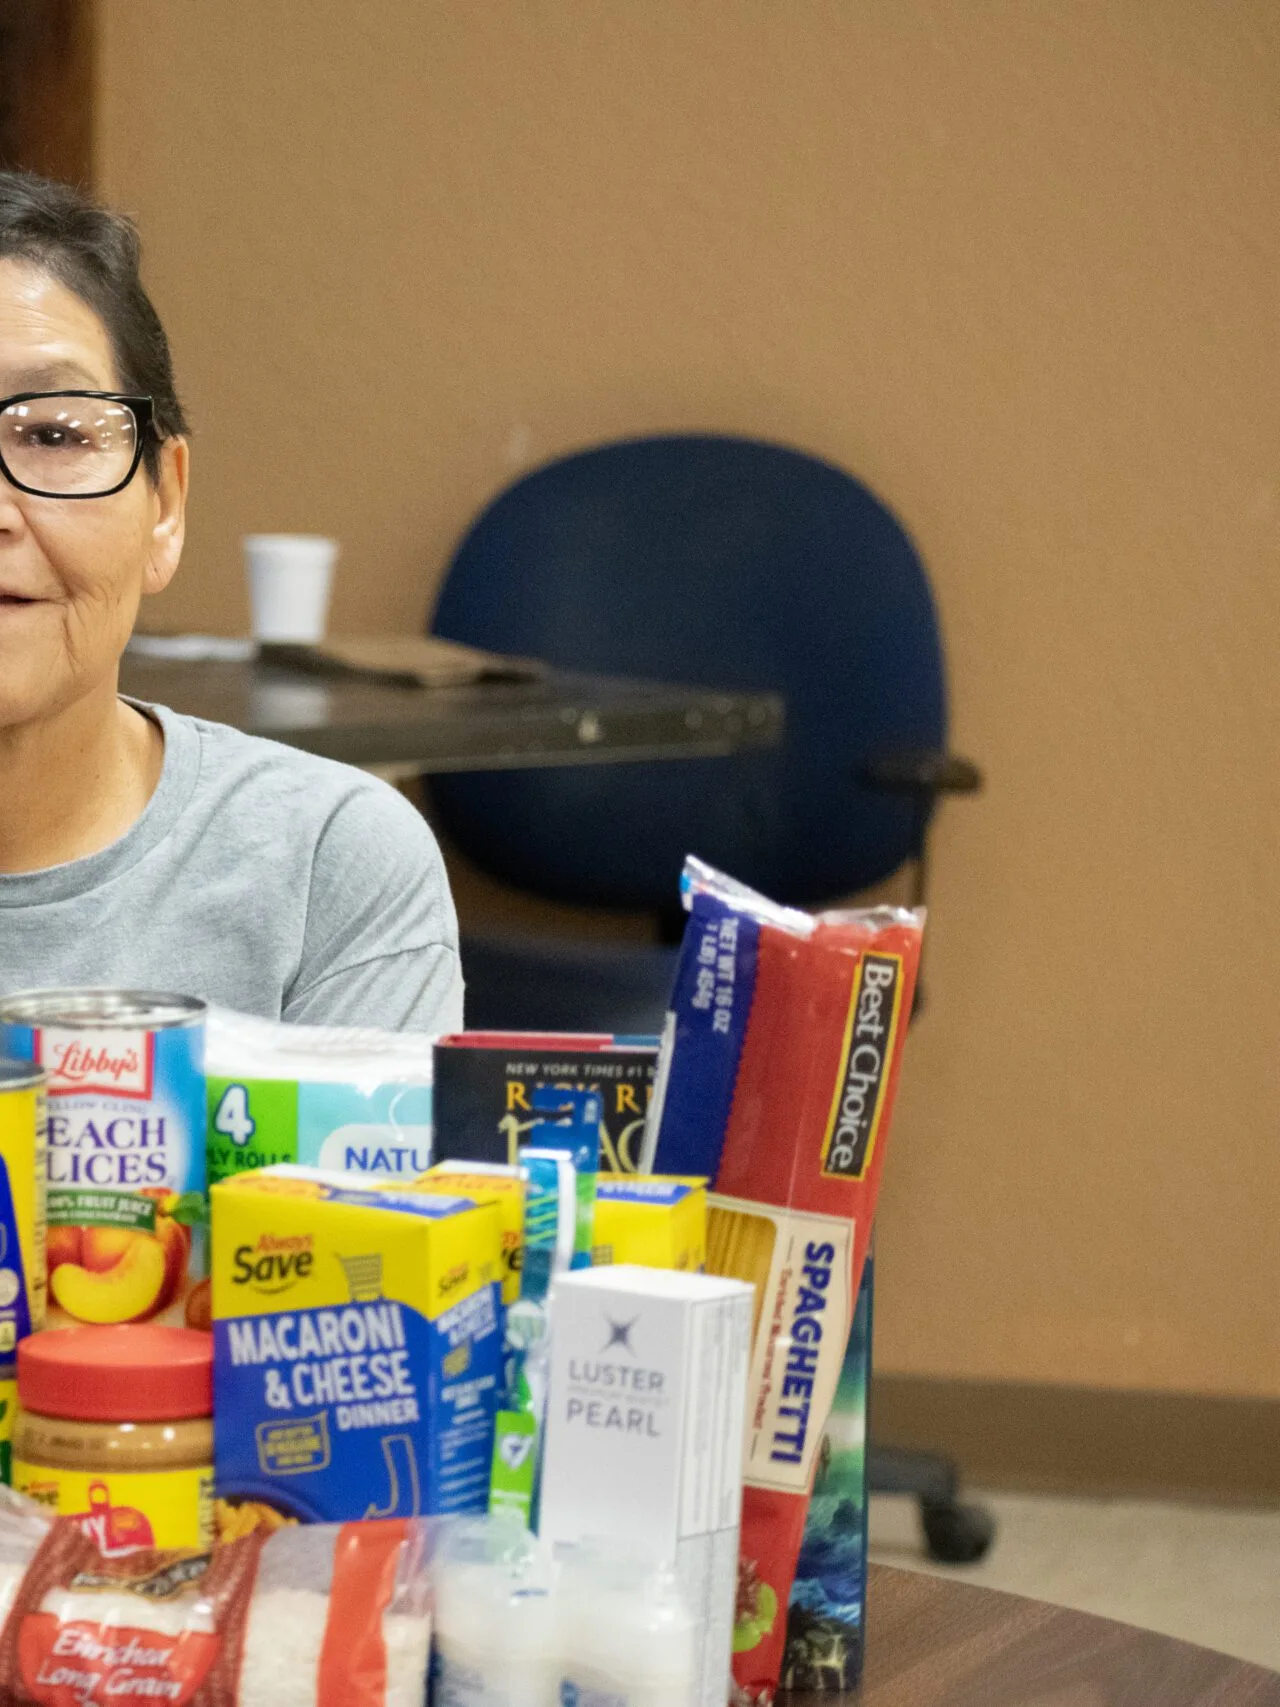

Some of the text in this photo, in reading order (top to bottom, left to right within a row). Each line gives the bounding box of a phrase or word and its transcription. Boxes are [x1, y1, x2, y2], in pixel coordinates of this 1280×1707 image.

[716, 955, 735, 984] WT
[712, 1008, 731, 1034] OZ
[54, 1041, 139, 1081] Libby's
[506, 1063, 538, 1076] NEW
[543, 1063, 578, 1076] YORK
[583, 1064, 624, 1077] TIMES
[830, 962, 895, 1169] Best Choice
[47, 1100, 97, 1112] ELLOW
[215, 1083, 256, 1146] 4
[47, 1116, 166, 1149] EACH
[46, 1151, 168, 1184] LICES
[258, 1234, 313, 1250] Always
[232, 1246, 314, 1285] Save
[228, 1303, 406, 1366] MACARONI
[770, 1241, 835, 1464] SPAGHETTI
[264, 1368, 293, 1410] &
[292, 1350, 417, 1406] CHEESE
[569, 1359, 666, 1394] LUSTER
[336, 1397, 420, 1431] DINNER
[566, 1398, 661, 1437] PEARL
[36, 1660, 183, 1704] Long Grain
